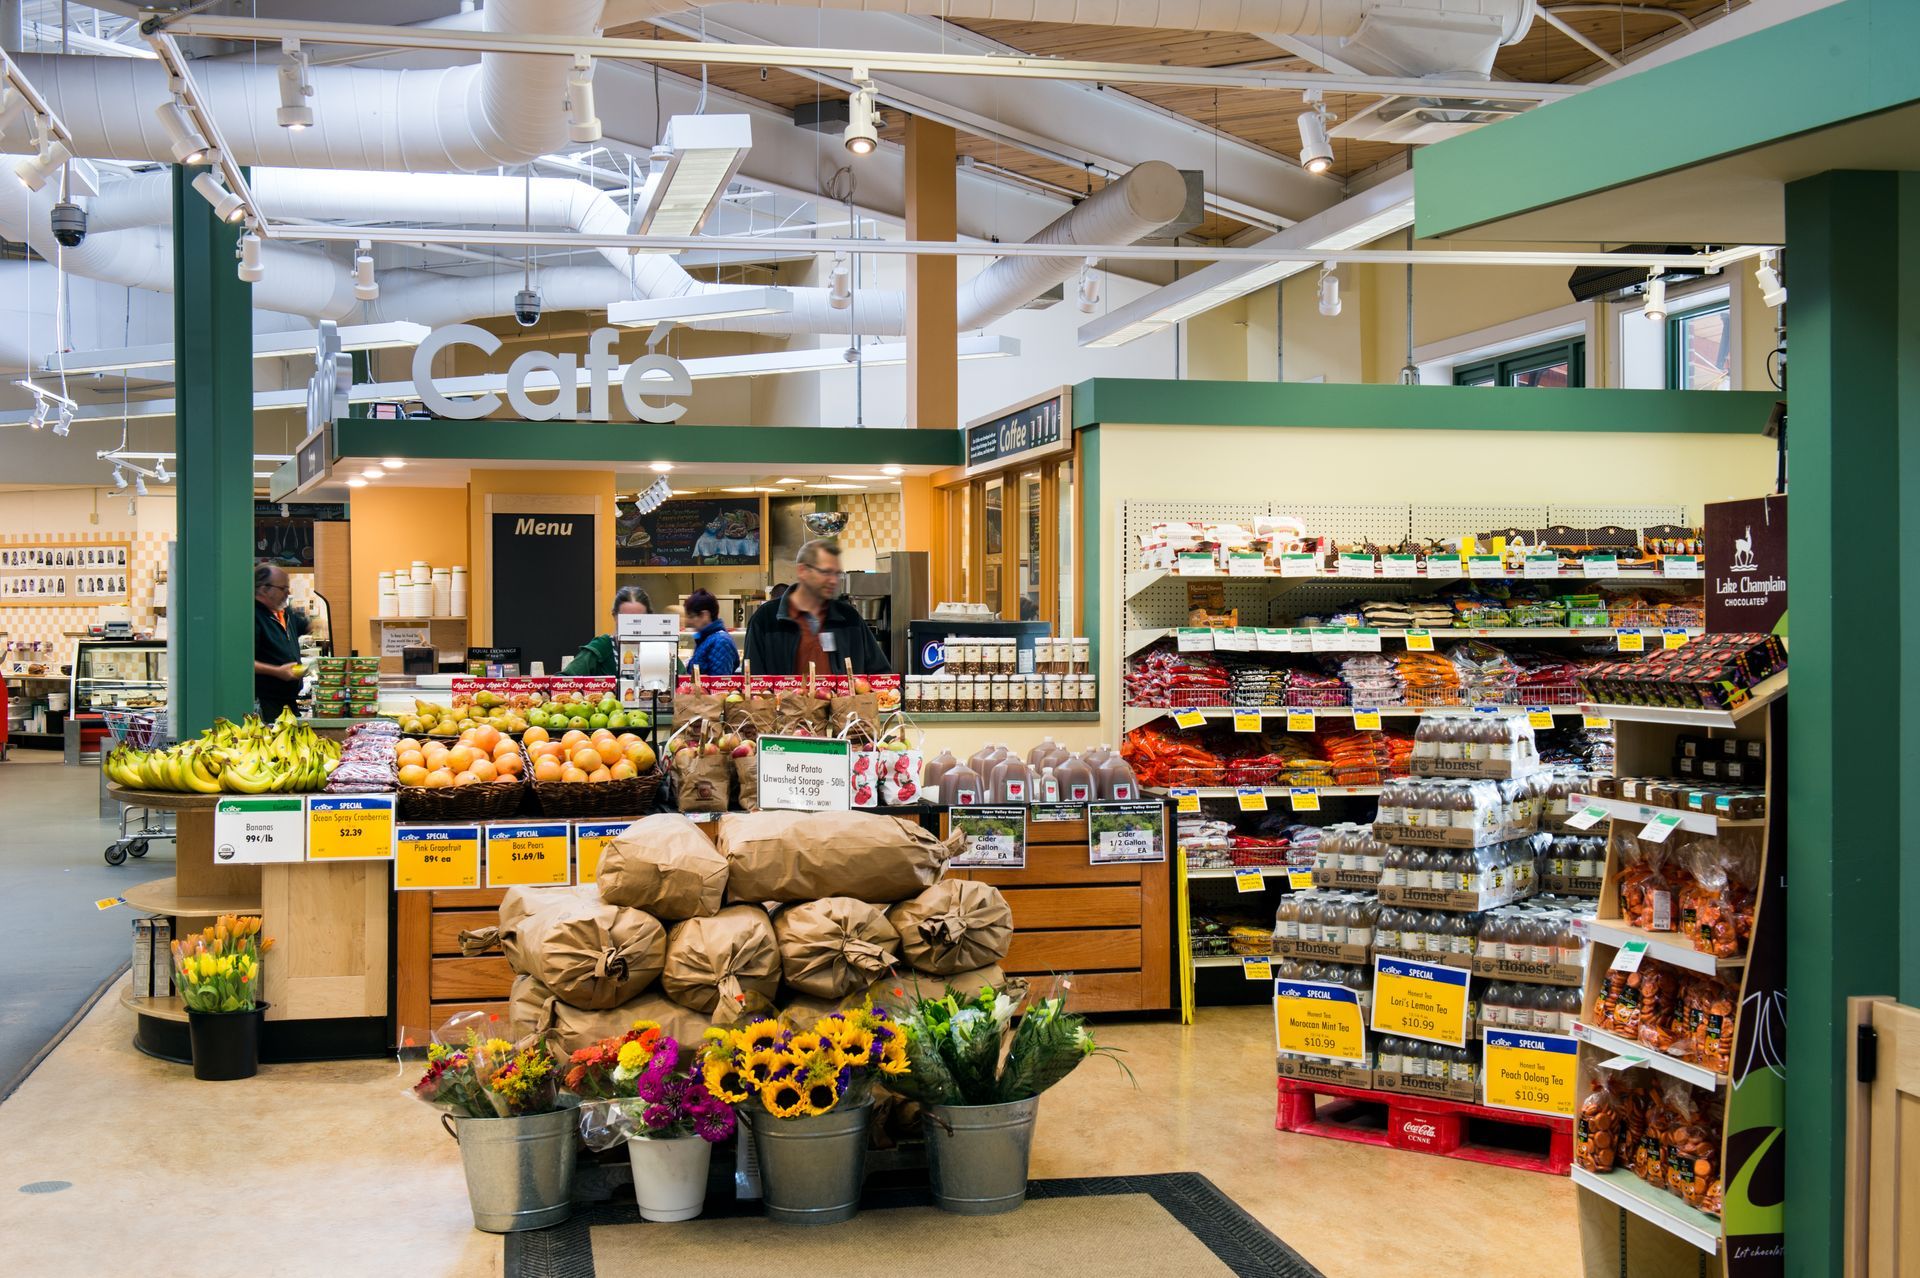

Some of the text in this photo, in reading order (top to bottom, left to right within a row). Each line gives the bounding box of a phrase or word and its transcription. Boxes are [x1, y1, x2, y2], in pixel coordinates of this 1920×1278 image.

[412, 321, 693, 424] Café
[1000, 419, 1027, 453] Coffee
[514, 518, 574, 537] Menu
[1716, 575, 1786, 595] Lake Champlain
[786, 764, 822, 774] Red Potato
[1433, 758, 1482, 770] Honest
[763, 774, 796, 784] Unwashed
[798, 776, 824, 787] Storage
[789, 787, 820, 796] $14.99
[340, 802, 362, 810] SPECIAL
[313, 813, 390, 822] Ocean Spray Cranberries
[340, 828, 362, 837] $2.39
[426, 832, 449, 840] SPECIAL
[516, 830, 539, 838] SPECIAL
[1399, 827, 1447, 839] Honest
[246, 834, 273, 844] 99¢/lb
[414, 843, 462, 852] Pink Grapefruit
[512, 842, 544, 850] Bosc Pears
[424, 855, 438, 863] 89¢
[512, 852, 544, 862] $1.69/lb
[1568, 878, 1601, 888] Hone
[1402, 888, 1449, 901] Honest
[1295, 941, 1341, 955] Honest
[1499, 960, 1551, 975] Honest
[1408, 968, 1434, 980] SPECIAL
[1307, 990, 1331, 999] SPECIAL
[1408, 990, 1432, 1000] Honest Tea
[1391, 996, 1448, 1014] Lori's Lemon Tea
[1290, 1018, 1349, 1032] Moroccan Mint Tea
[1401, 1017, 1434, 1030] $10.99
[1304, 1038, 1336, 1048] $10.99
[1519, 1039, 1545, 1050] SPECIAL
[1298, 1063, 1344, 1080] Honest
[1501, 1069, 1564, 1086] Peach Oolong Tea
[1401, 1076, 1449, 1092] Honest
[1515, 1090, 1549, 1103] $10.99
[1408, 1135, 1430, 1144] CCNNE
[1734, 1245, 1784, 1258] Let chocolat
